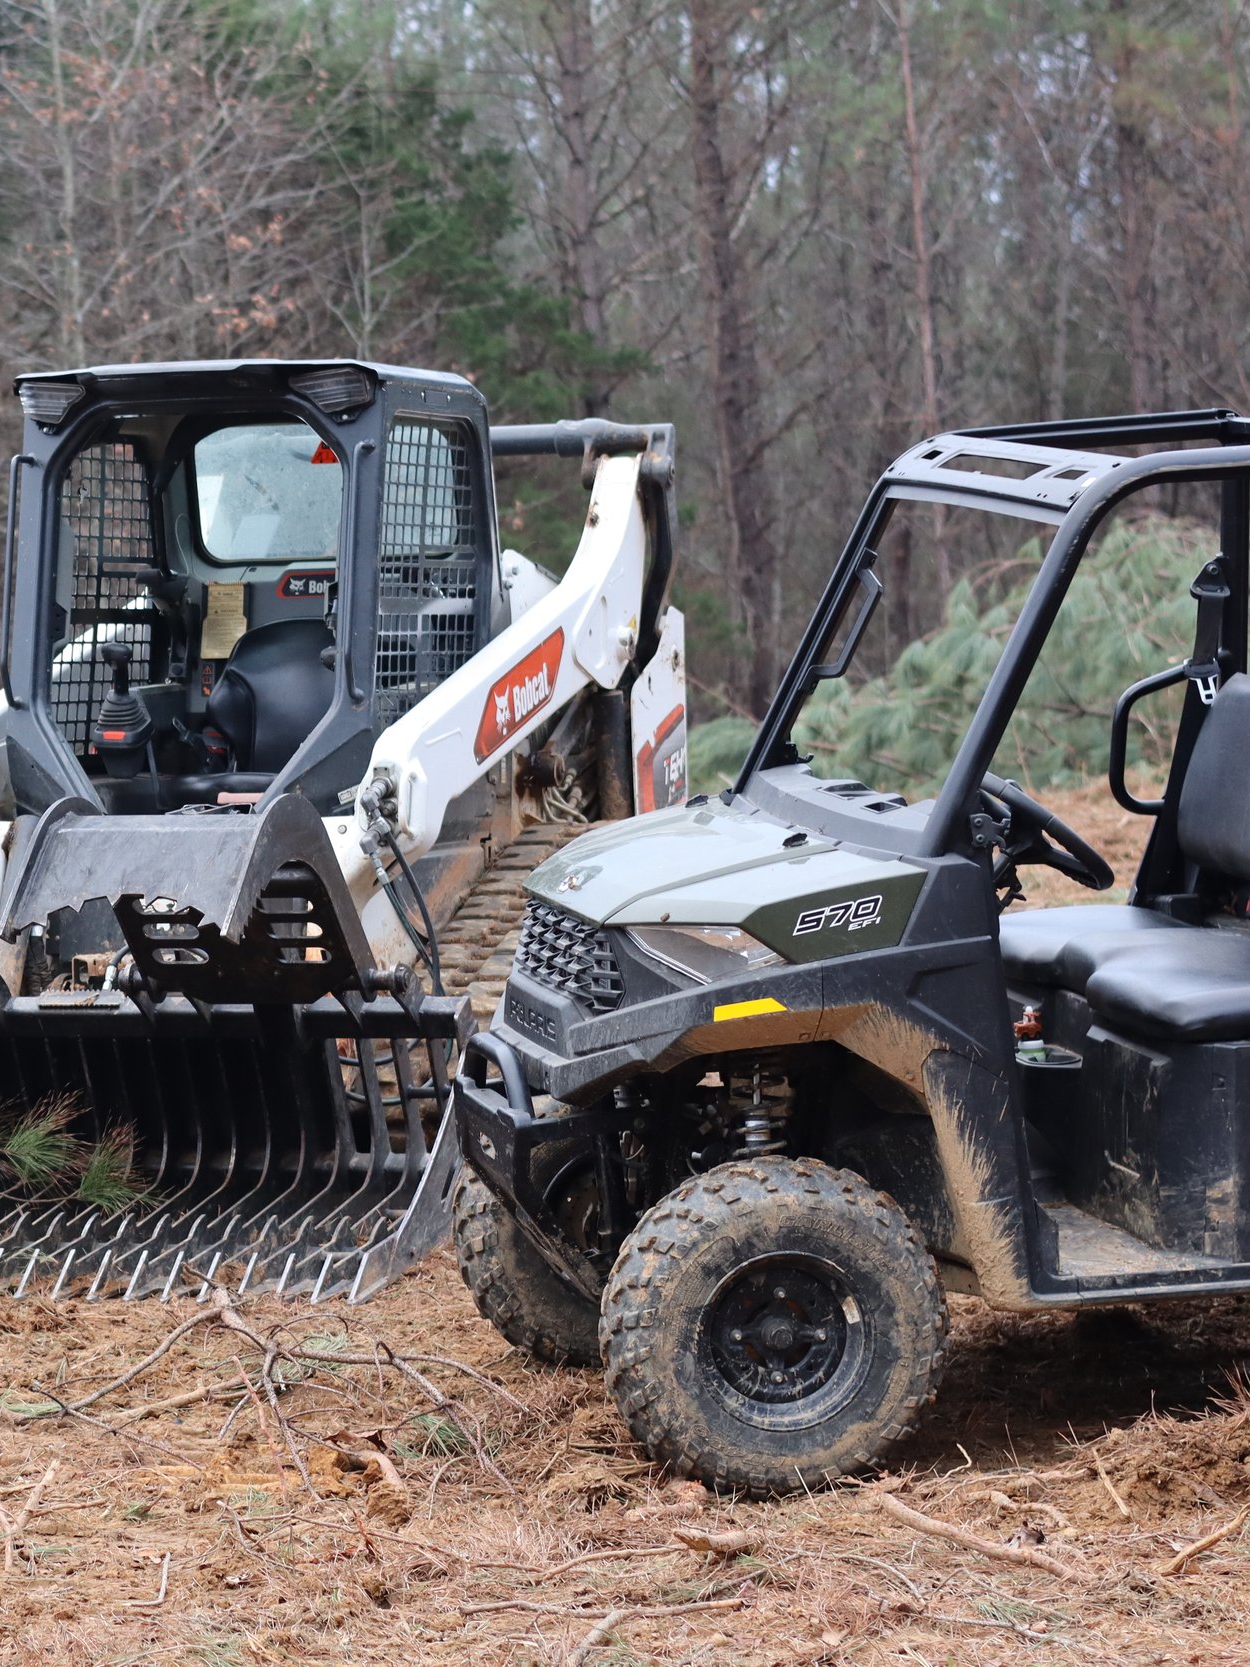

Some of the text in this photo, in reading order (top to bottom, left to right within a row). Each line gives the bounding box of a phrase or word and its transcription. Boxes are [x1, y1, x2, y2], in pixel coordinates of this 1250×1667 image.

[308, 579, 331, 594] Bob
[512, 662, 550, 723] Bobcat
[792, 894, 882, 936] 570
[847, 916, 882, 932] EFI
[510, 1000, 556, 1042] POLARIS
